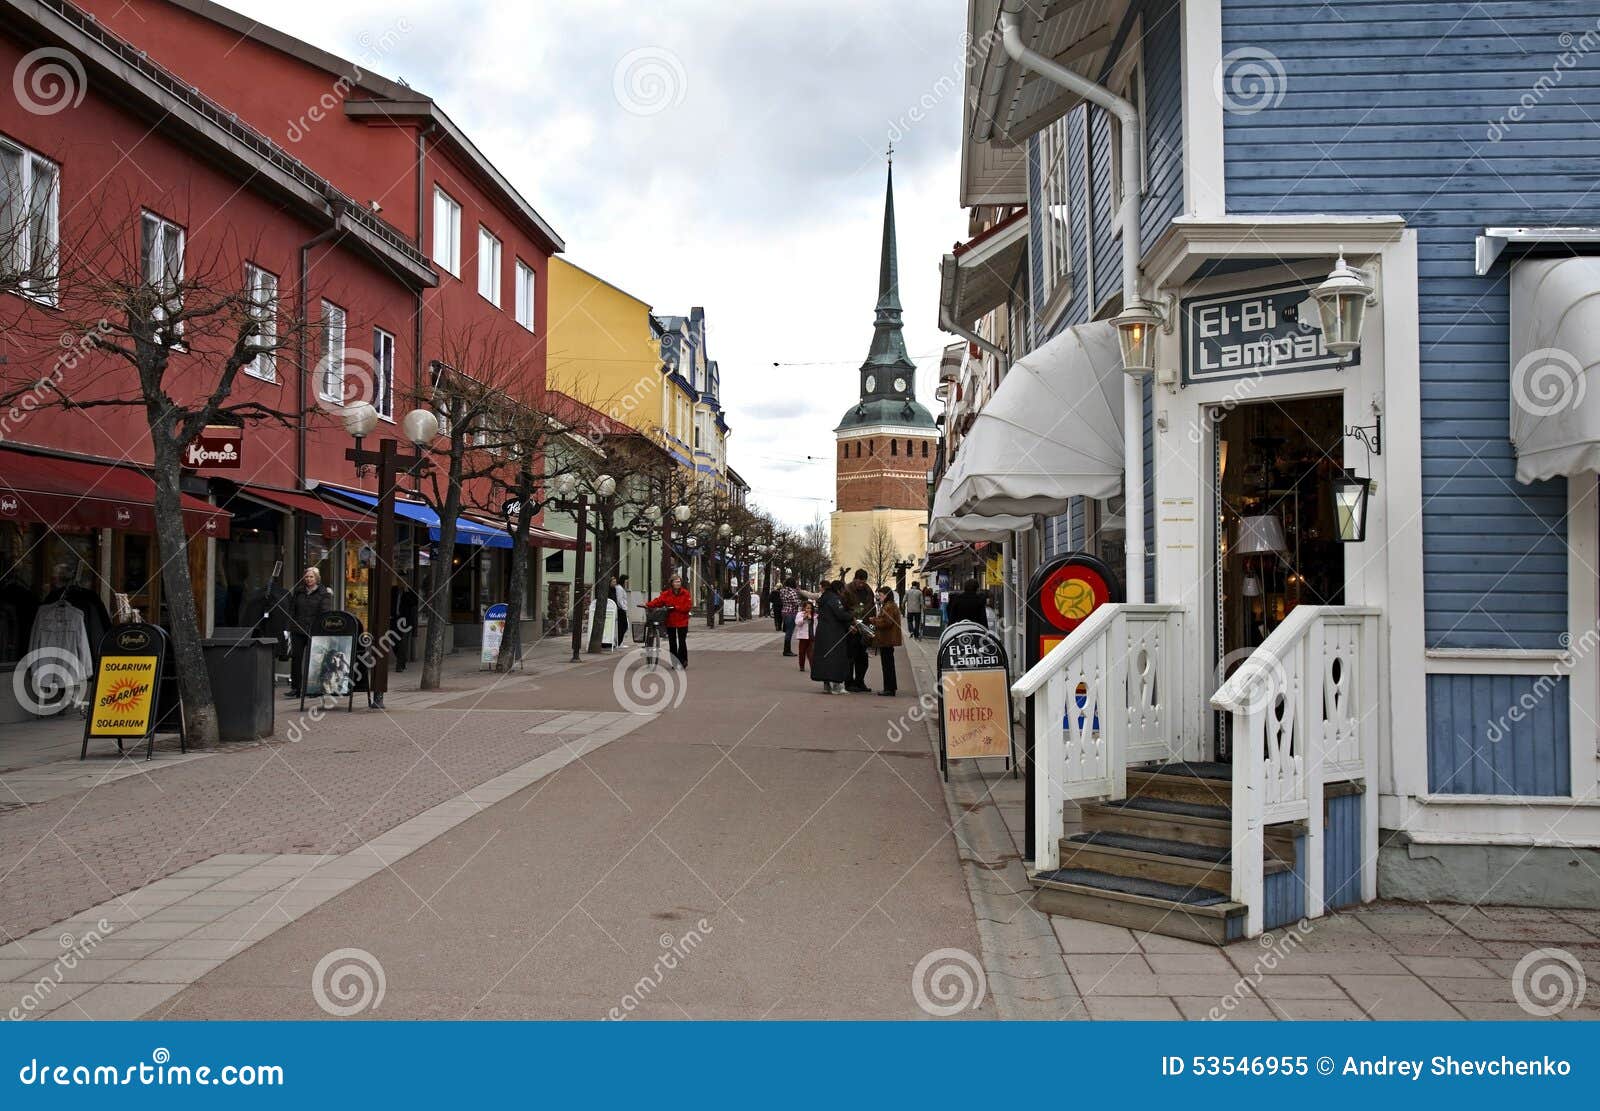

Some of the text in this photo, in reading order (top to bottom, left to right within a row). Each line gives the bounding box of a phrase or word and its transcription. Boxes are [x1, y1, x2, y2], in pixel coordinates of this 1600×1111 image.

[188, 442, 238, 467] Kompis
[105, 663, 152, 672] SOLARIUM
[950, 655, 999, 668] Lampan
[100, 684, 149, 707] SOLARIUM
[956, 683, 981, 702] VÅR
[96, 720, 144, 728] SOLARIUM
